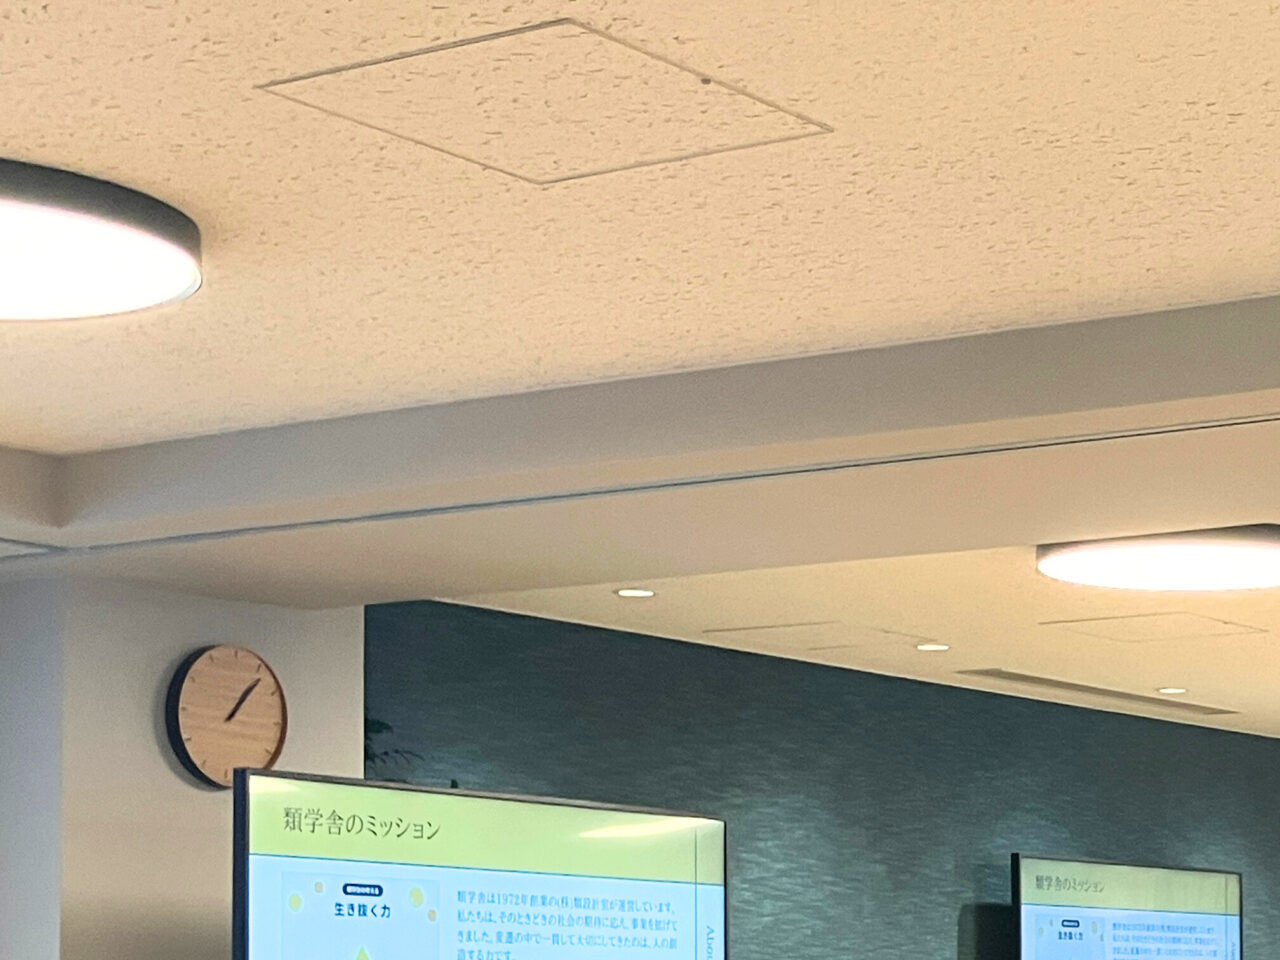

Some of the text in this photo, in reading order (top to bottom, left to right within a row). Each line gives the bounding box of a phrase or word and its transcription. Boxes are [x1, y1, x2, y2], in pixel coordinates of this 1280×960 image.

[283, 806, 441, 841] 類学舎のミッション
[334, 902, 391, 919] 生き抜く力
